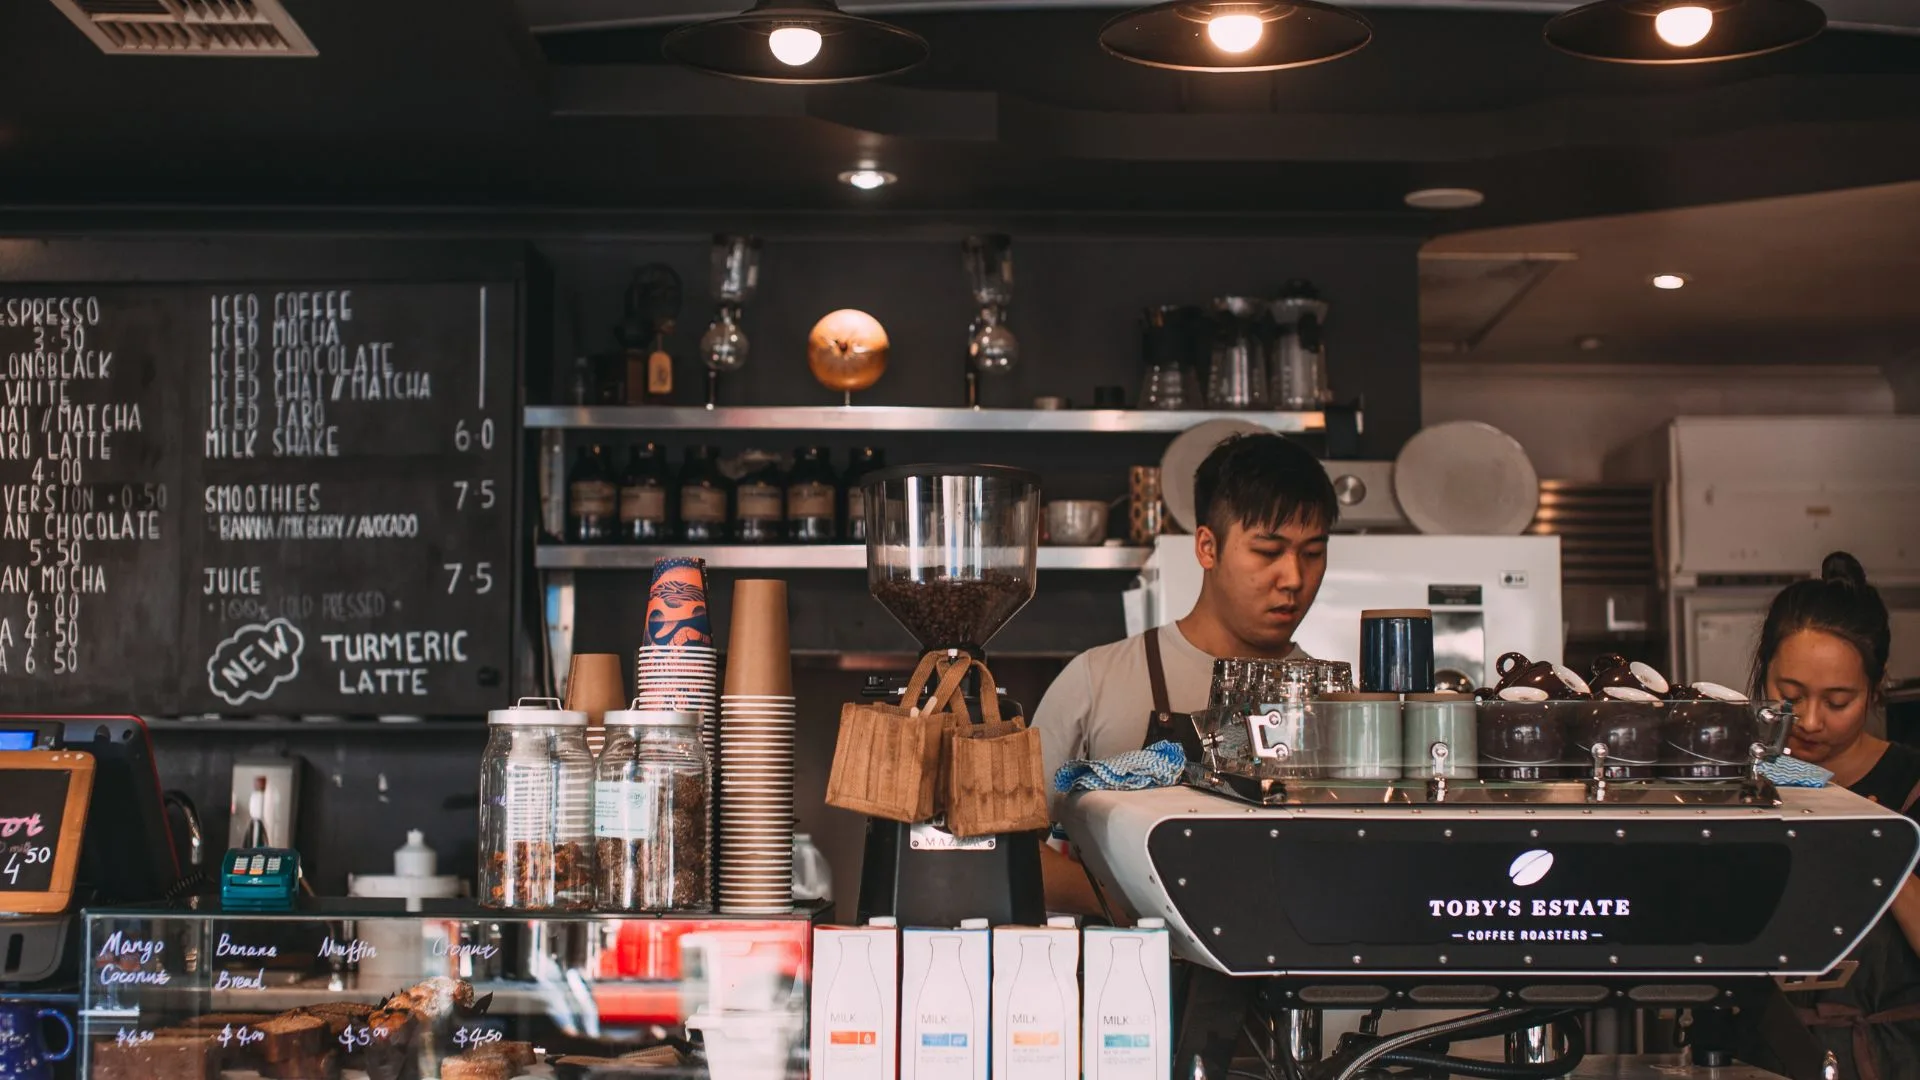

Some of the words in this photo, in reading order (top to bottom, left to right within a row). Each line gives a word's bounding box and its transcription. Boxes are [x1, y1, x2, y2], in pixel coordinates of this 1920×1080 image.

[210, 293, 260, 324] ICED
[274, 290, 353, 320] COFFEE
[210, 321, 260, 350] ICED
[272, 318, 340, 348] MOCHA
[209, 348, 260, 376] ICED
[272, 342, 395, 378] CHOCOLATE
[4, 379, 71, 408] WHITE
[210, 375, 260, 402] ICED
[274, 374, 323, 402] CHAI
[210, 401, 260, 430] ICED
[275, 399, 326, 429] TARO
[47, 430, 112, 460] LATTE
[205, 429, 258, 459] MILK
[272, 426, 340, 458] SHAKE
[4, 483, 94, 513] VERSION
[204, 482, 322, 513] SMOOTHIES
[3, 513, 30, 540] AN
[44, 510, 161, 541] CHOCOLATE
[0, 565, 29, 594] AN
[41, 565, 107, 594] MOCHA
[202, 566, 262, 596] JUICE
[221, 624, 291, 690] NEW
[320, 630, 469, 663] TURMERIC
[339, 668, 430, 696] LATTE
[925, 836, 982, 848] MAZR
[1429, 899, 1522, 917] TOBY'S
[1531, 899, 1631, 916] ESTATE
[100, 930, 165, 964] Mango
[215, 932, 278, 958] Banana
[432, 936, 499, 960] Cronut
[1467, 929, 1515, 941] COFFEE
[1520, 929, 1588, 941] ROASTERS
[317, 936, 377, 964] Muffin
[100, 963, 171, 986] Coconut
[215, 968, 267, 992] Bread
[452, 1026, 503, 1051] $4.50
